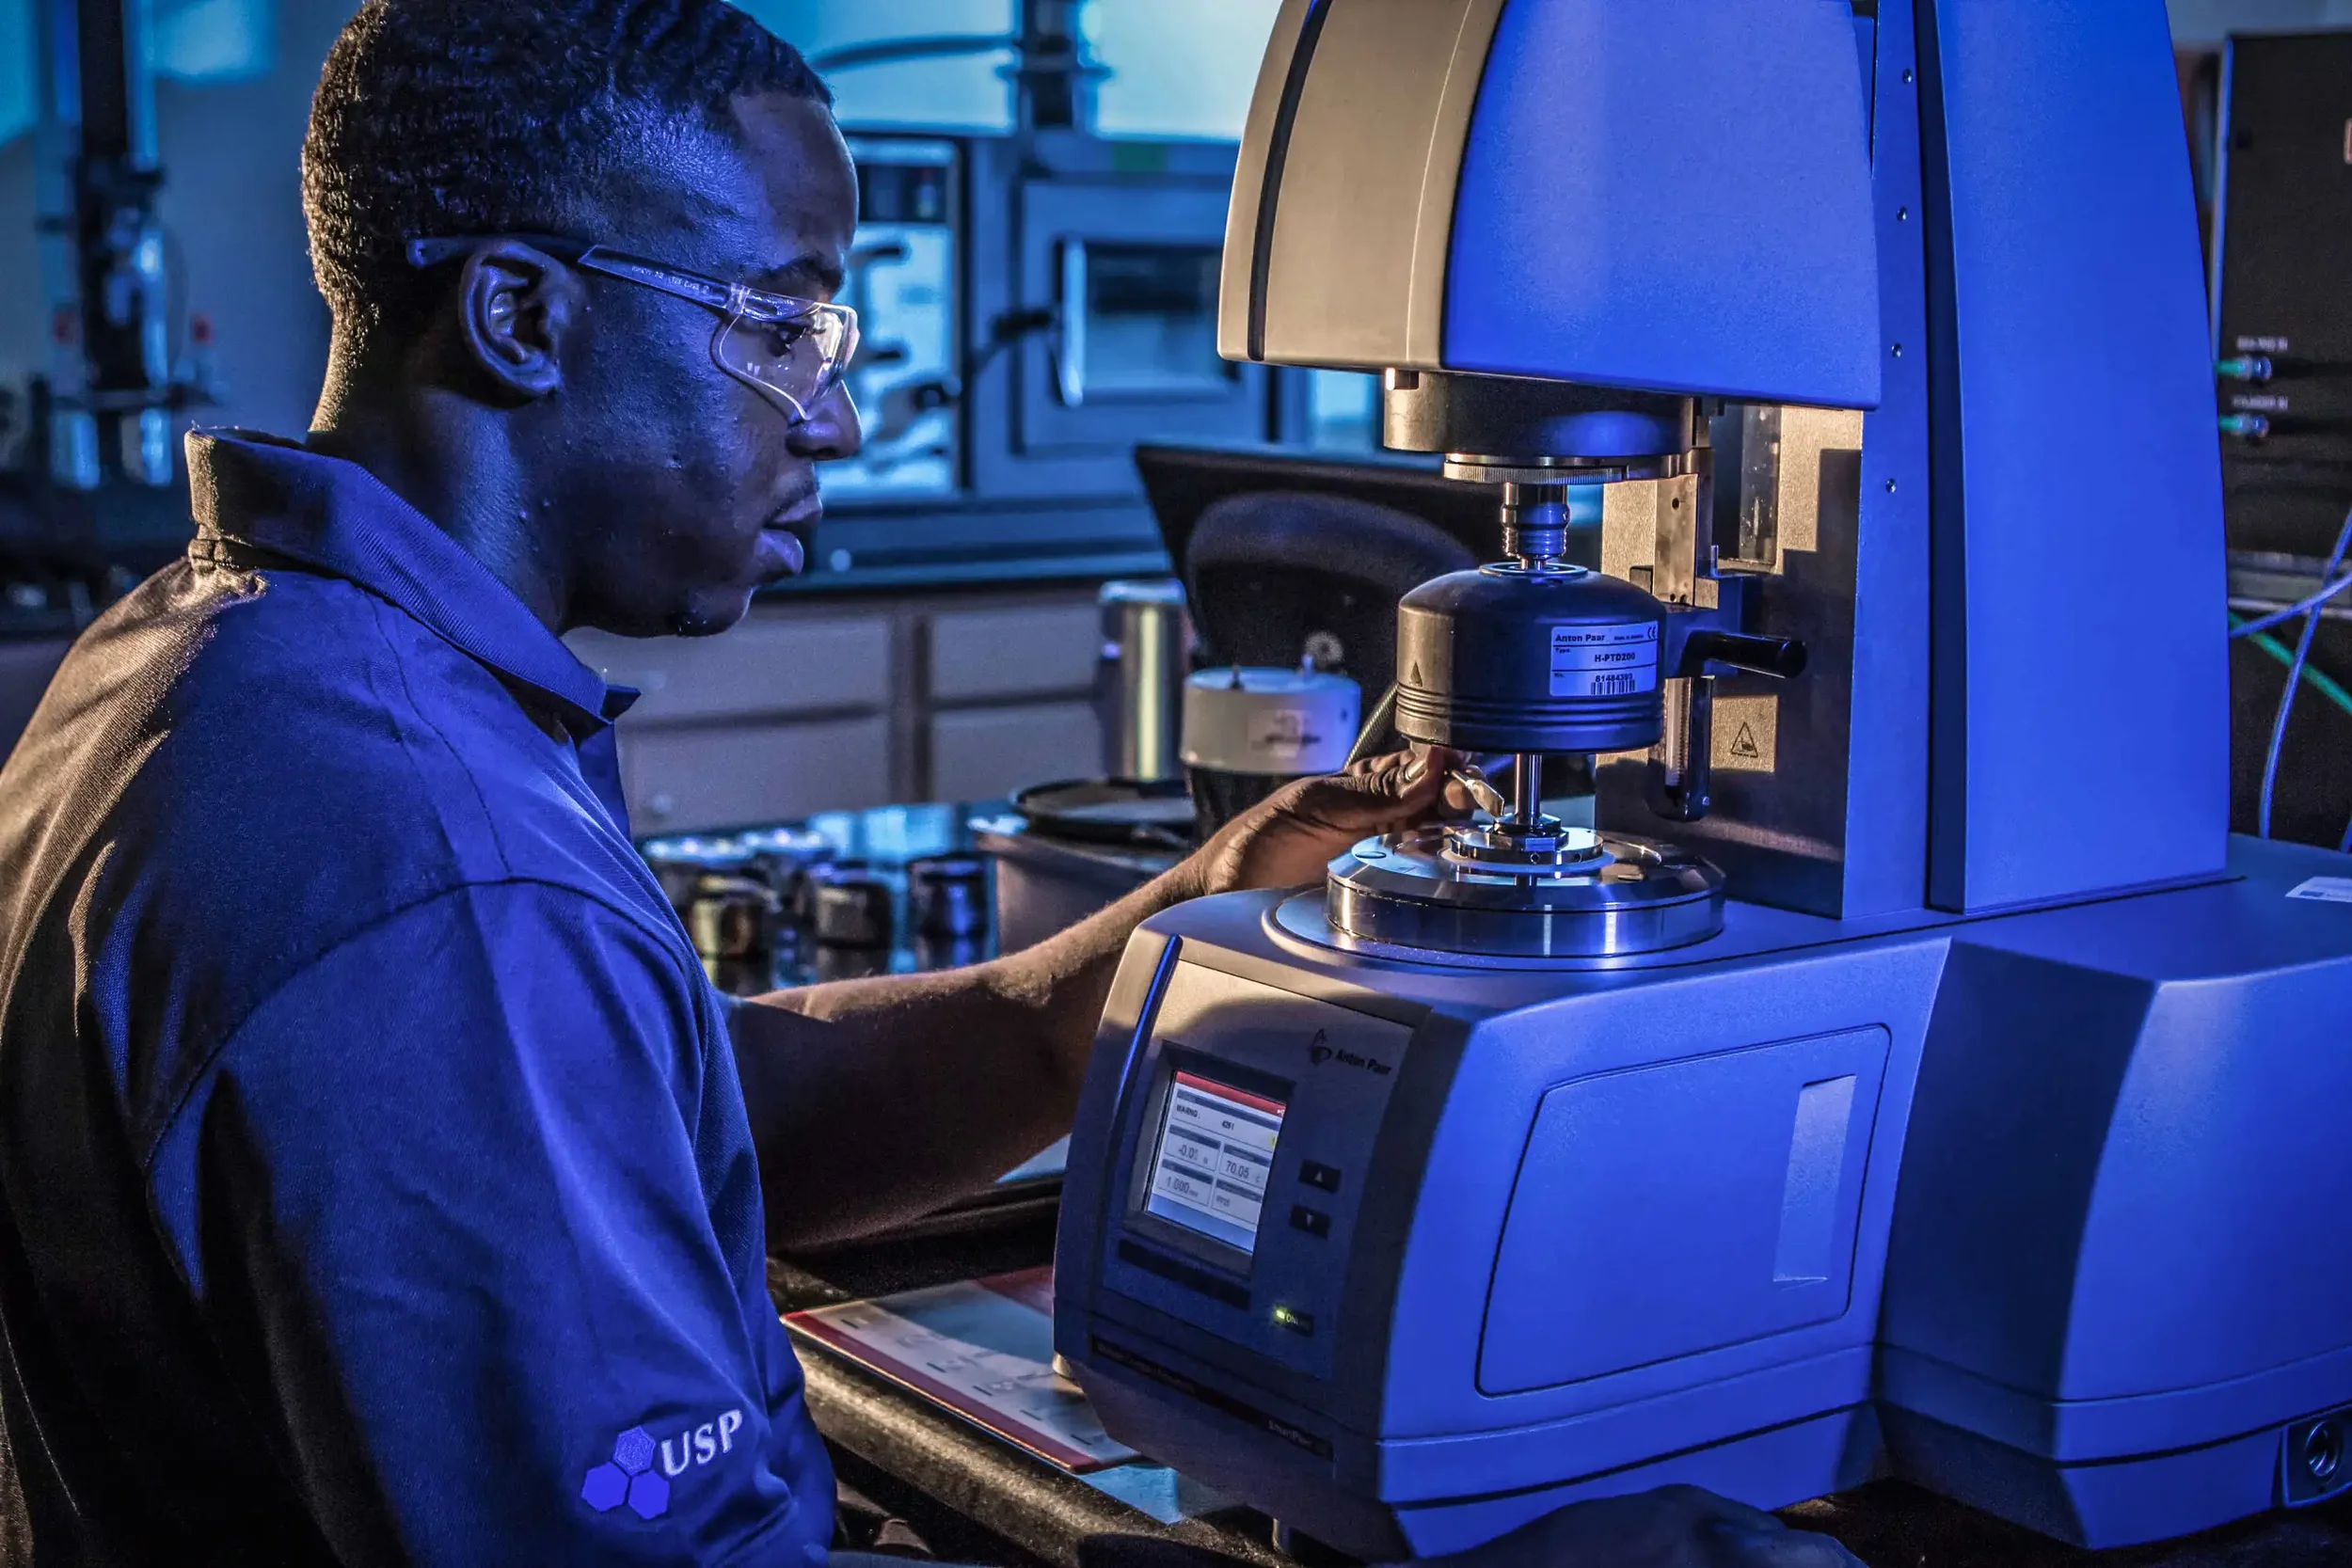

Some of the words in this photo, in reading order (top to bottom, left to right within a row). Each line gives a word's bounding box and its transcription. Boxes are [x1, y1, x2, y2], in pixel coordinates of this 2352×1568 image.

[1555, 634, 1583, 642] Anton
[1594, 652, 1636, 663] H-PTD200
[661, 1409, 743, 1476] USP
